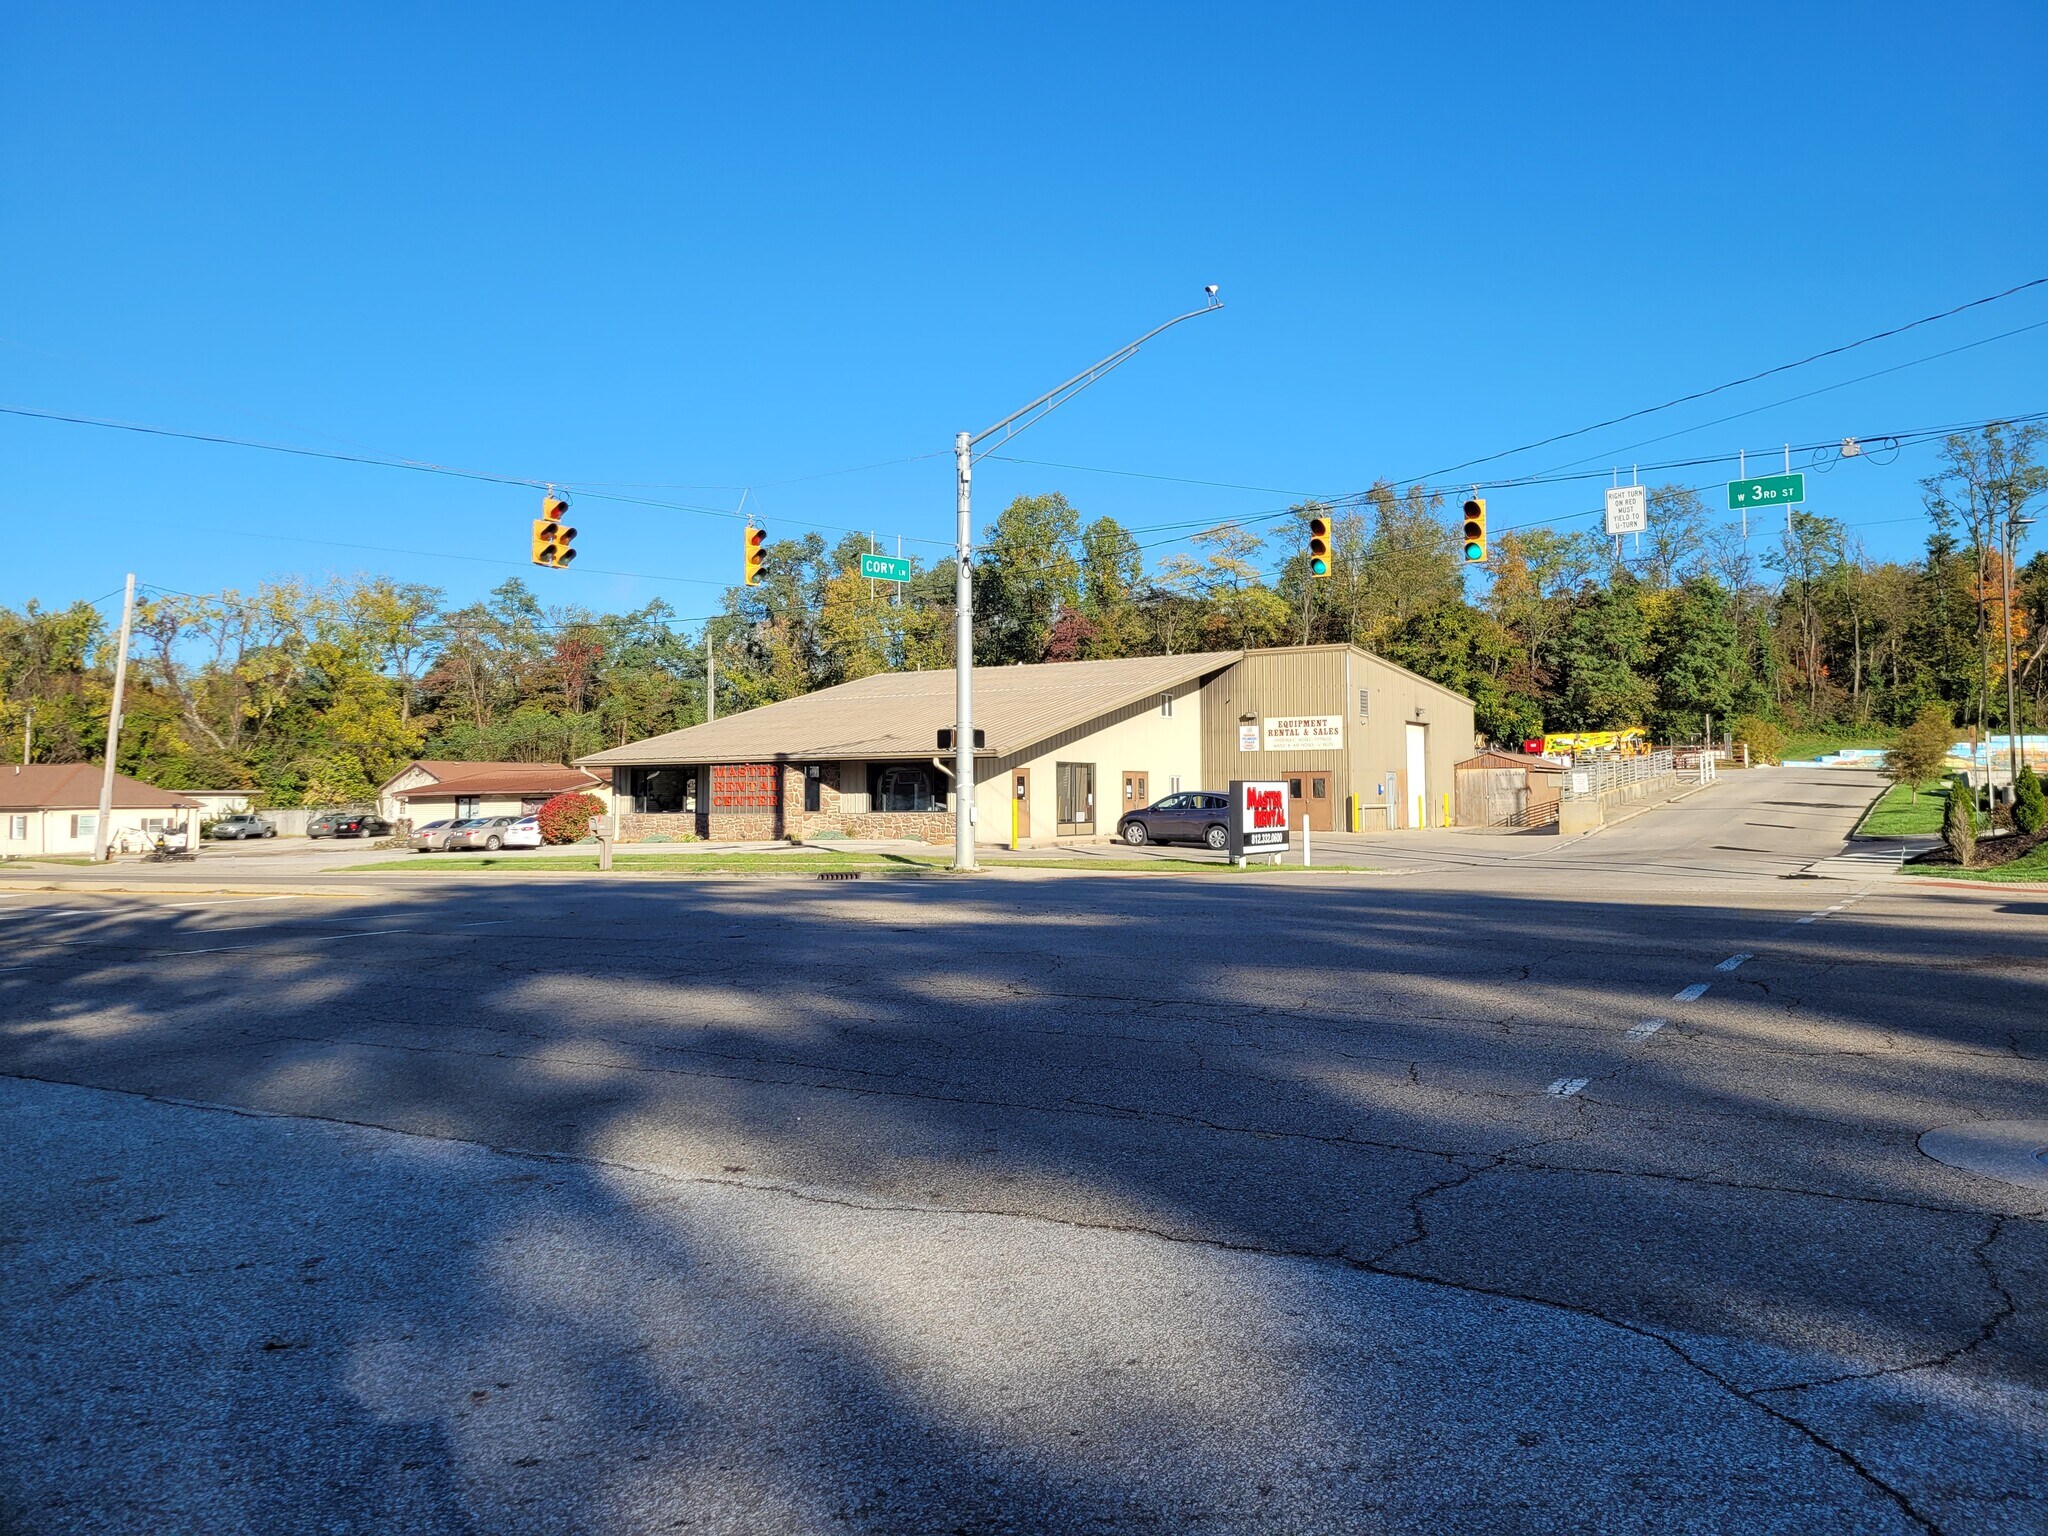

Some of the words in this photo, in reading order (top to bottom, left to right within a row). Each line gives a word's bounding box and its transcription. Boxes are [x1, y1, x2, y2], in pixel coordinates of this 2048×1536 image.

[1608, 492, 1625, 500] RIGHT
[1627, 490, 1643, 498] TURN
[1737, 493, 1746, 502] W
[1752, 485, 1777, 500] 3RD
[1782, 488, 1794, 497] ST
[1615, 521, 1638, 529] U-TURN
[866, 560, 895, 575] CORY
[898, 569, 906, 577] LN
[1278, 719, 1328, 728] EQUIPMENT
[1268, 728, 1300, 737] RENTAL
[1303, 728, 1309, 736] &
[1313, 727, 1339, 736] SALES
[714, 766, 779, 778] MASTER
[714, 780, 779, 792] RENTAL
[713, 796, 779, 806] CENTER
[1247, 786, 1283, 810] MASTER
[1254, 809, 1286, 828] RENTAL
